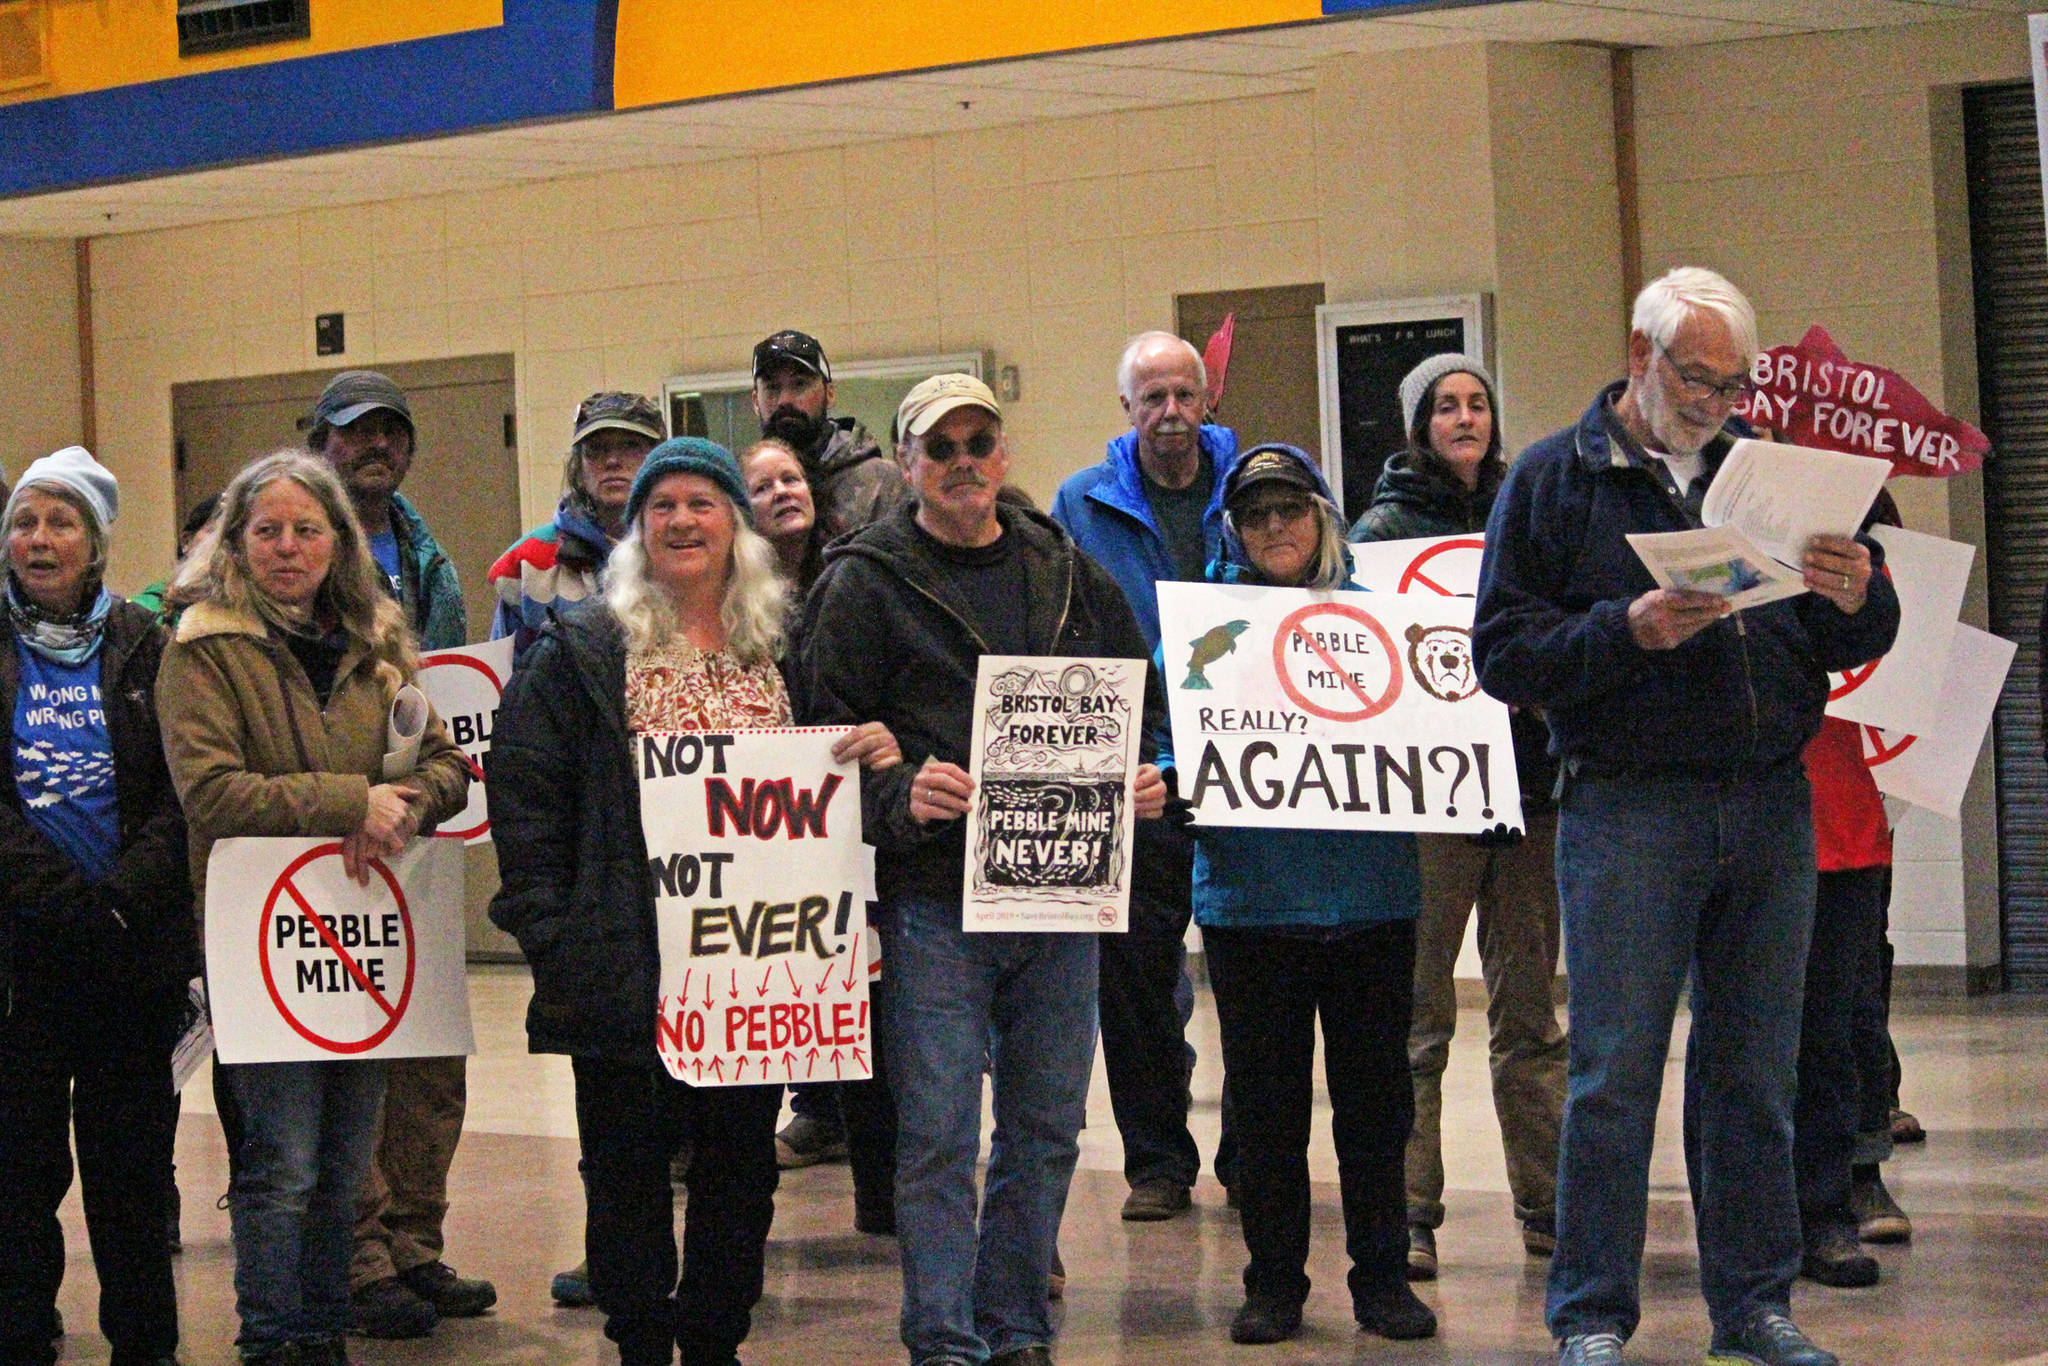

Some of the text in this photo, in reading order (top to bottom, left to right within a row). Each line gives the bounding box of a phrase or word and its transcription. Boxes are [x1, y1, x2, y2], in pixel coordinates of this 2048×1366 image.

[1426, 328, 1456, 338] LUNCH
[1750, 352, 1890, 410] BRISTOL
[1813, 402, 1961, 471] FOREVER
[1293, 632, 1370, 654] PEBBLE
[30, 684, 88, 707] WONG
[1001, 694, 1120, 715] BRISTOL BAY
[26, 707, 86, 730] WRNG
[1199, 706, 1309, 734] REALLY?
[1009, 724, 1099, 746] FOREVER
[643, 735, 735, 779] NOT
[1191, 739, 1494, 819] AGAIN?!
[704, 772, 844, 841] NOW
[990, 810, 1112, 832] PEBBLE MINE
[995, 838, 1102, 866] NEVER!
[649, 853, 734, 898] NOT
[276, 914, 399, 948] PEBBLE
[689, 890, 854, 961] EVER!
[975, 912, 994, 922] April
[296, 959, 386, 993] MINE
[656, 1001, 868, 1053] NO PEBBLE!
